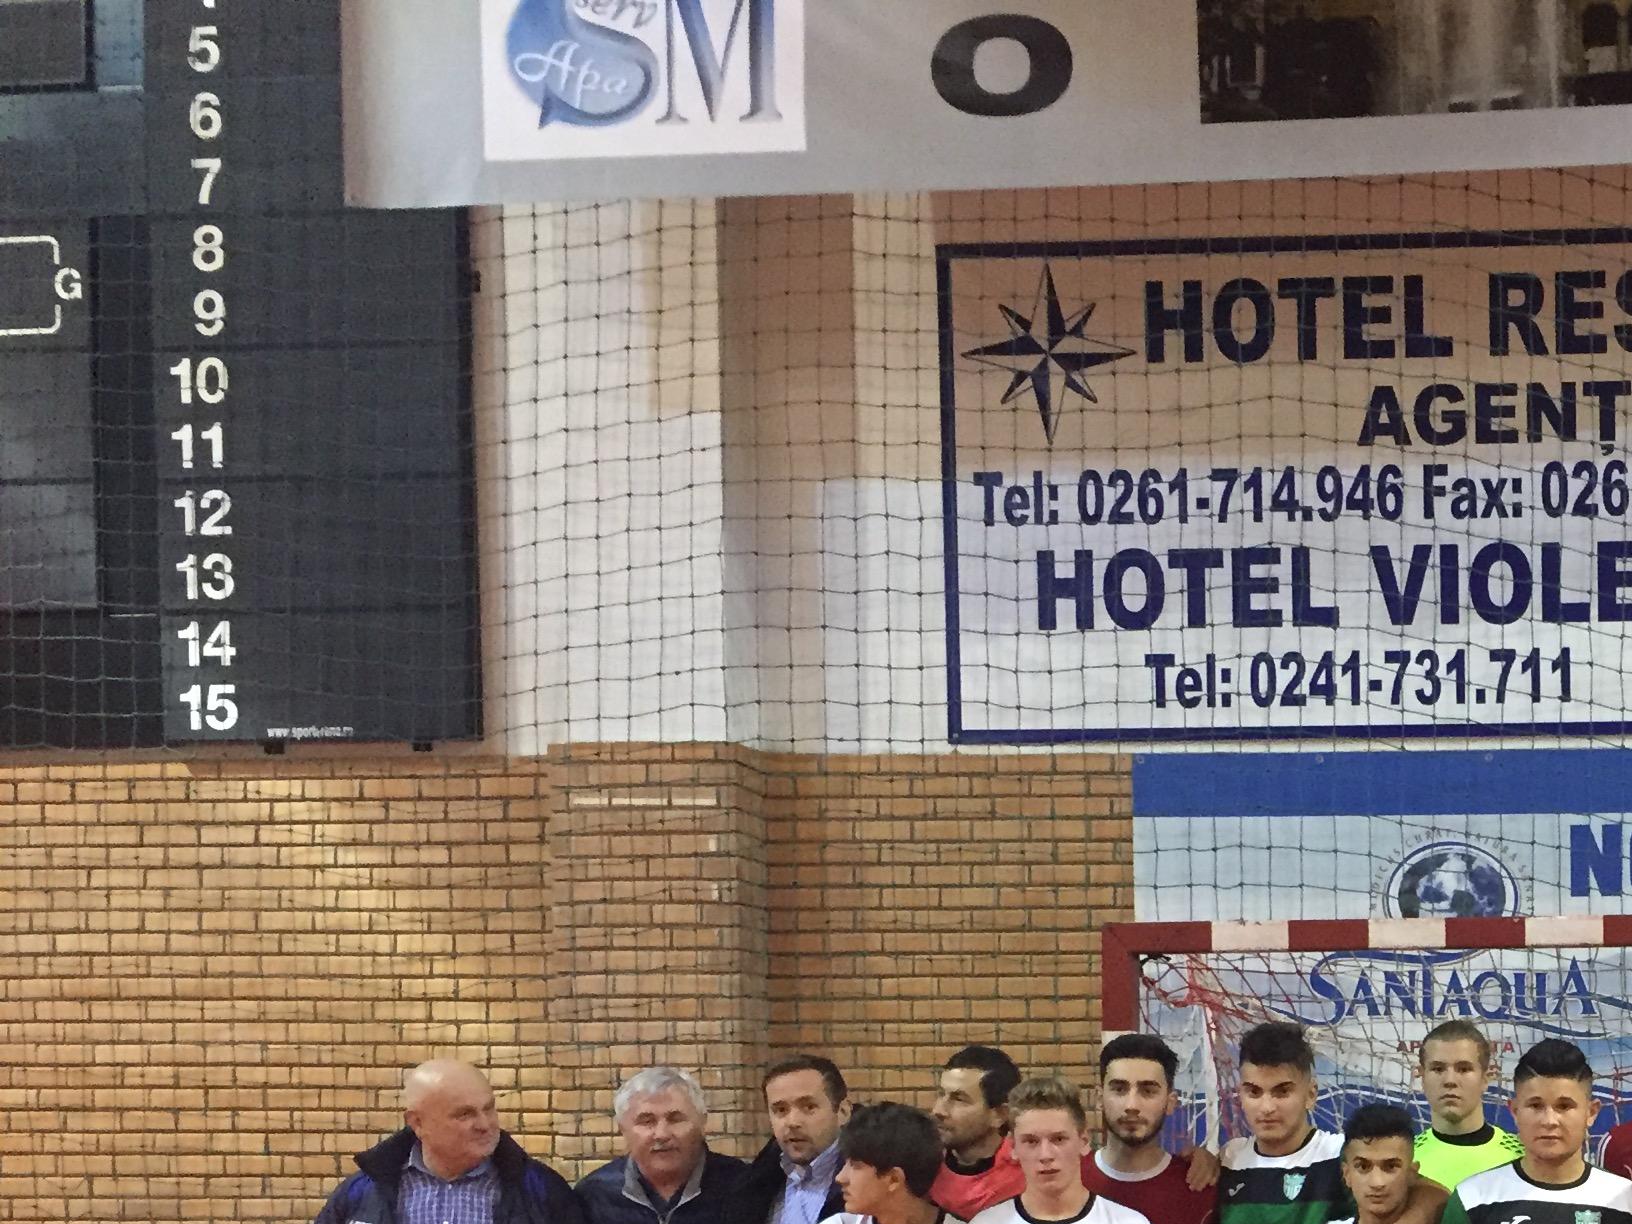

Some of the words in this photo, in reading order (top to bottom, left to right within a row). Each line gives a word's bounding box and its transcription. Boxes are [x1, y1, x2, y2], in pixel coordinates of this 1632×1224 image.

[188, 25, 220, 73] 5
[514, 40, 628, 109] Apa
[189, 91, 222, 140] 6
[191, 157, 222, 205] 7
[192, 224, 224, 272] 8
[54, 267, 83, 300] G
[193, 289, 226, 337] 9
[1144, 273, 1454, 367] HOTEL
[169, 356, 229, 405] 10
[171, 421, 223, 469] 11
[173, 489, 233, 536] 12
[973, 471, 1059, 527] Tel:
[1077, 464, 1404, 526] 0261-714.946
[1423, 463, 1523, 521] Fax:
[175, 552, 235, 600] 13
[1036, 544, 1340, 632] HOTEL
[177, 620, 237, 667] 14
[1145, 653, 1232, 709] Tel:
[1250, 647, 1572, 708] 0241-731.711
[179, 683, 239, 731] 15
